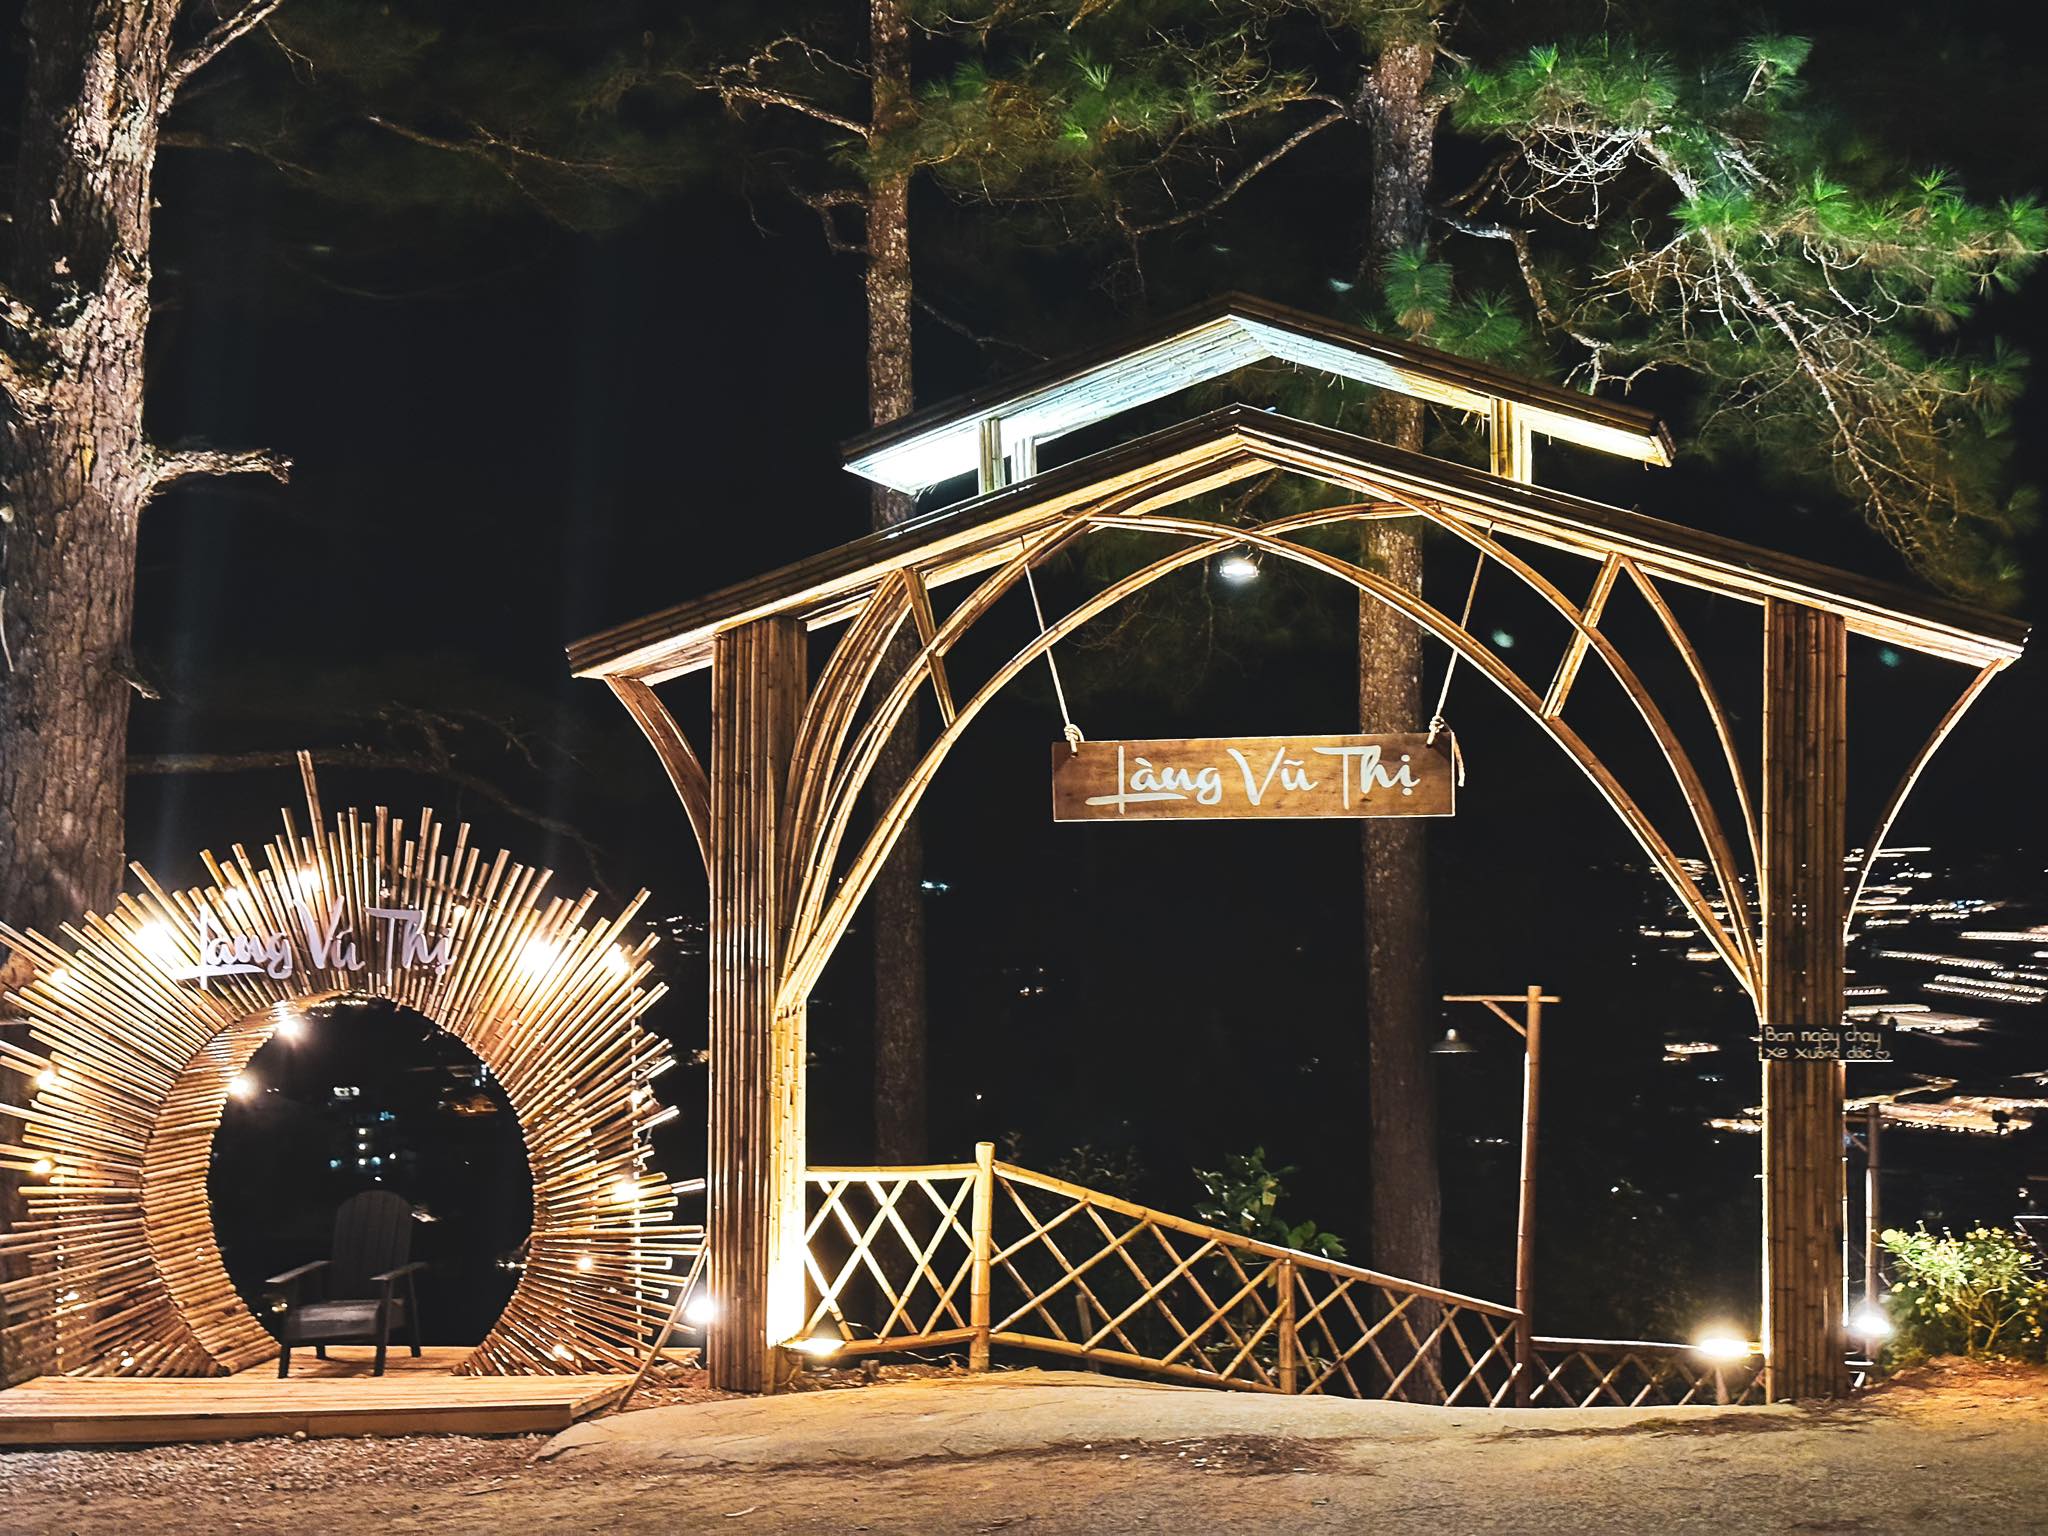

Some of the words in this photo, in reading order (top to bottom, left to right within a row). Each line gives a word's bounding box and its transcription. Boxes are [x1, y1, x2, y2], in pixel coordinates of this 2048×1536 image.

[1085, 745, 1222, 815] Làng
[1225, 746, 1320, 806] Vũ
[1312, 745, 1421, 811] Thị
[365, 906, 458, 989] Thị
[1764, 1026, 1795, 1042] Ban
[1800, 1027, 1840, 1050] ngày
